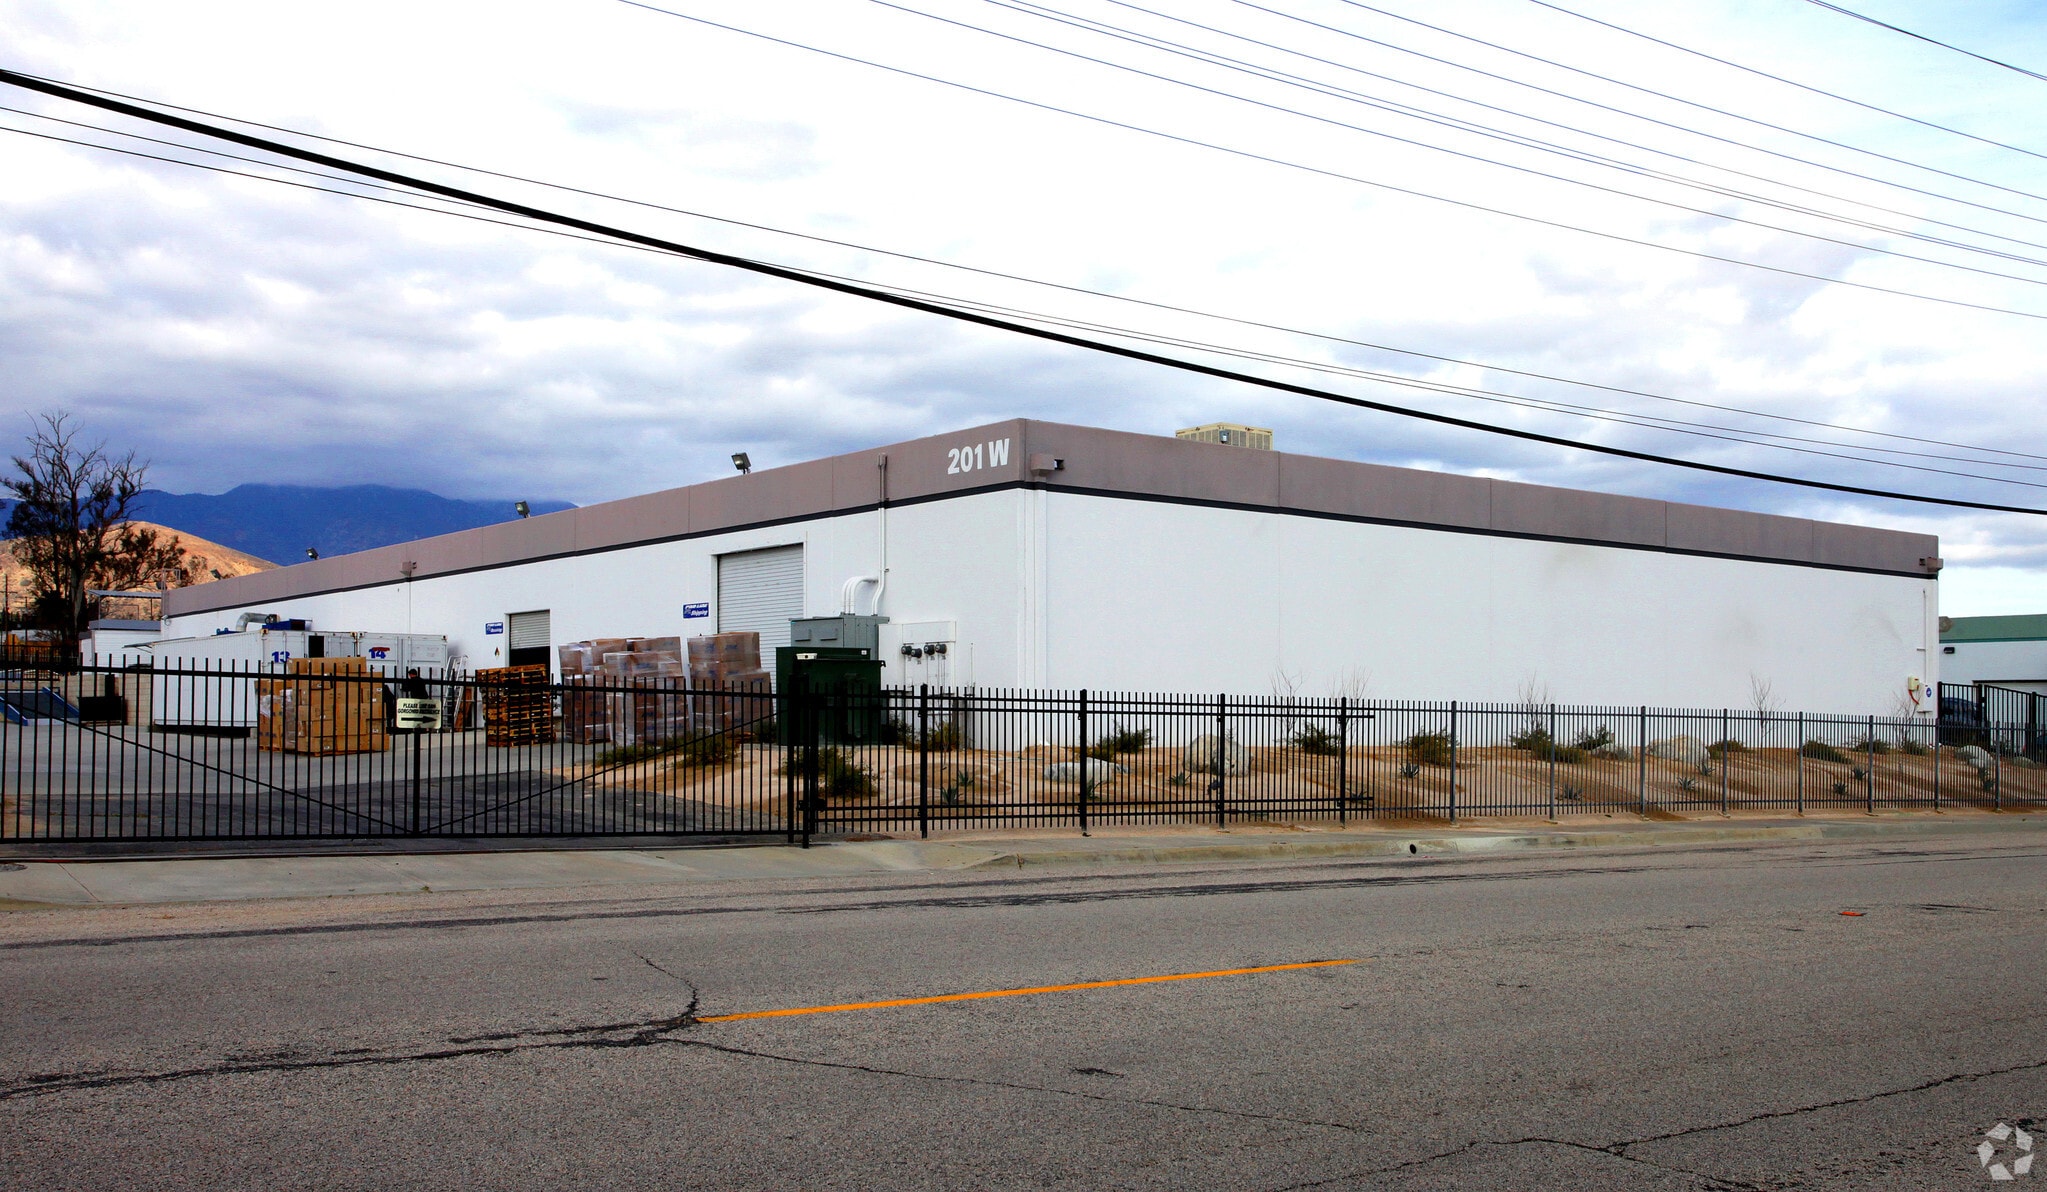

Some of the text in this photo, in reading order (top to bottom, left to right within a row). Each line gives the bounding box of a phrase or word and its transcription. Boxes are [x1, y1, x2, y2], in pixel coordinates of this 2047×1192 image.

[947, 438, 1010, 475] 201 W
[271, 651, 290, 663] 13
[368, 648, 387, 659] 14
